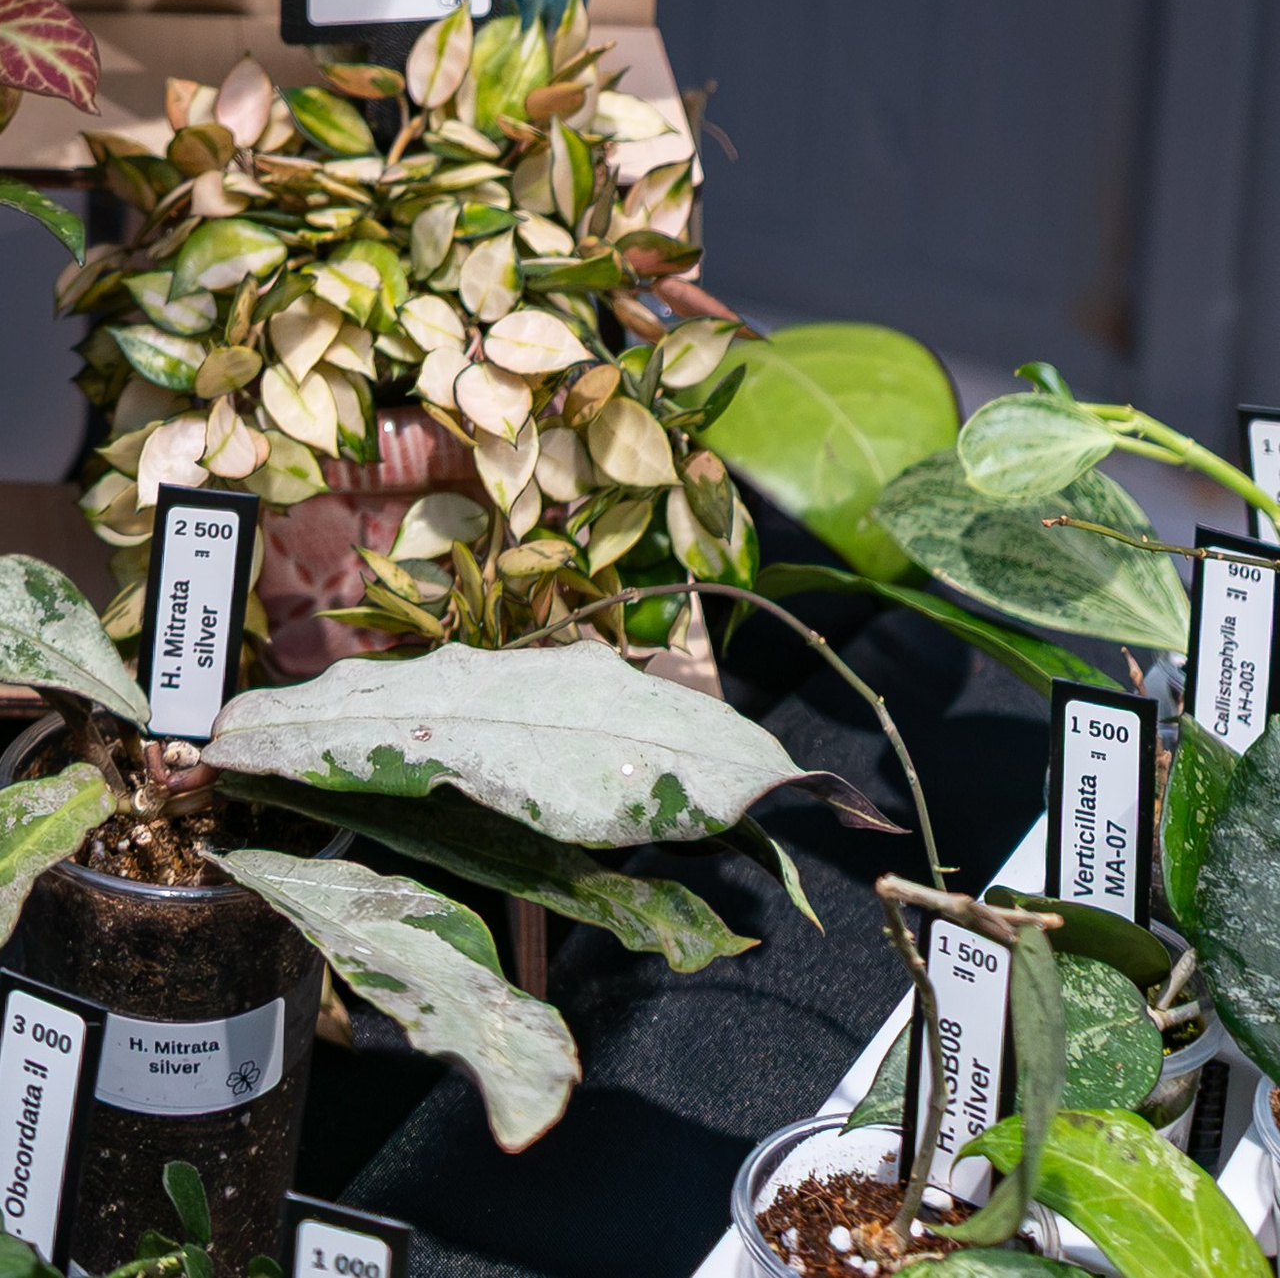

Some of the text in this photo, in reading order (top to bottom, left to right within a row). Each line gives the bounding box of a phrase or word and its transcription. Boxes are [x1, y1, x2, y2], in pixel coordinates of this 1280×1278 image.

[174, 520, 233, 540] 2 500
[1228, 563, 1262, 583] 900
[160, 579, 190, 689] H. Mitrata
[193, 605, 218, 669] silver
[1214, 615, 1239, 737] Callistophylla
[1237, 660, 1256, 727] AH-003
[1071, 715, 1129, 743] 1 500
[1073, 774, 1098, 897] Verticillata
[1104, 819, 1128, 898] MA-07
[938, 935, 998, 974] 1 500
[12, 1014, 72, 1055] 3 000
[129, 1036, 221, 1056] H. Mitrata
[149, 1059, 201, 1075] silver
[963, 1056, 991, 1137] silver
[4, 1083, 44, 1219] Obcordata
[312, 1247, 380, 1278] 1 000
